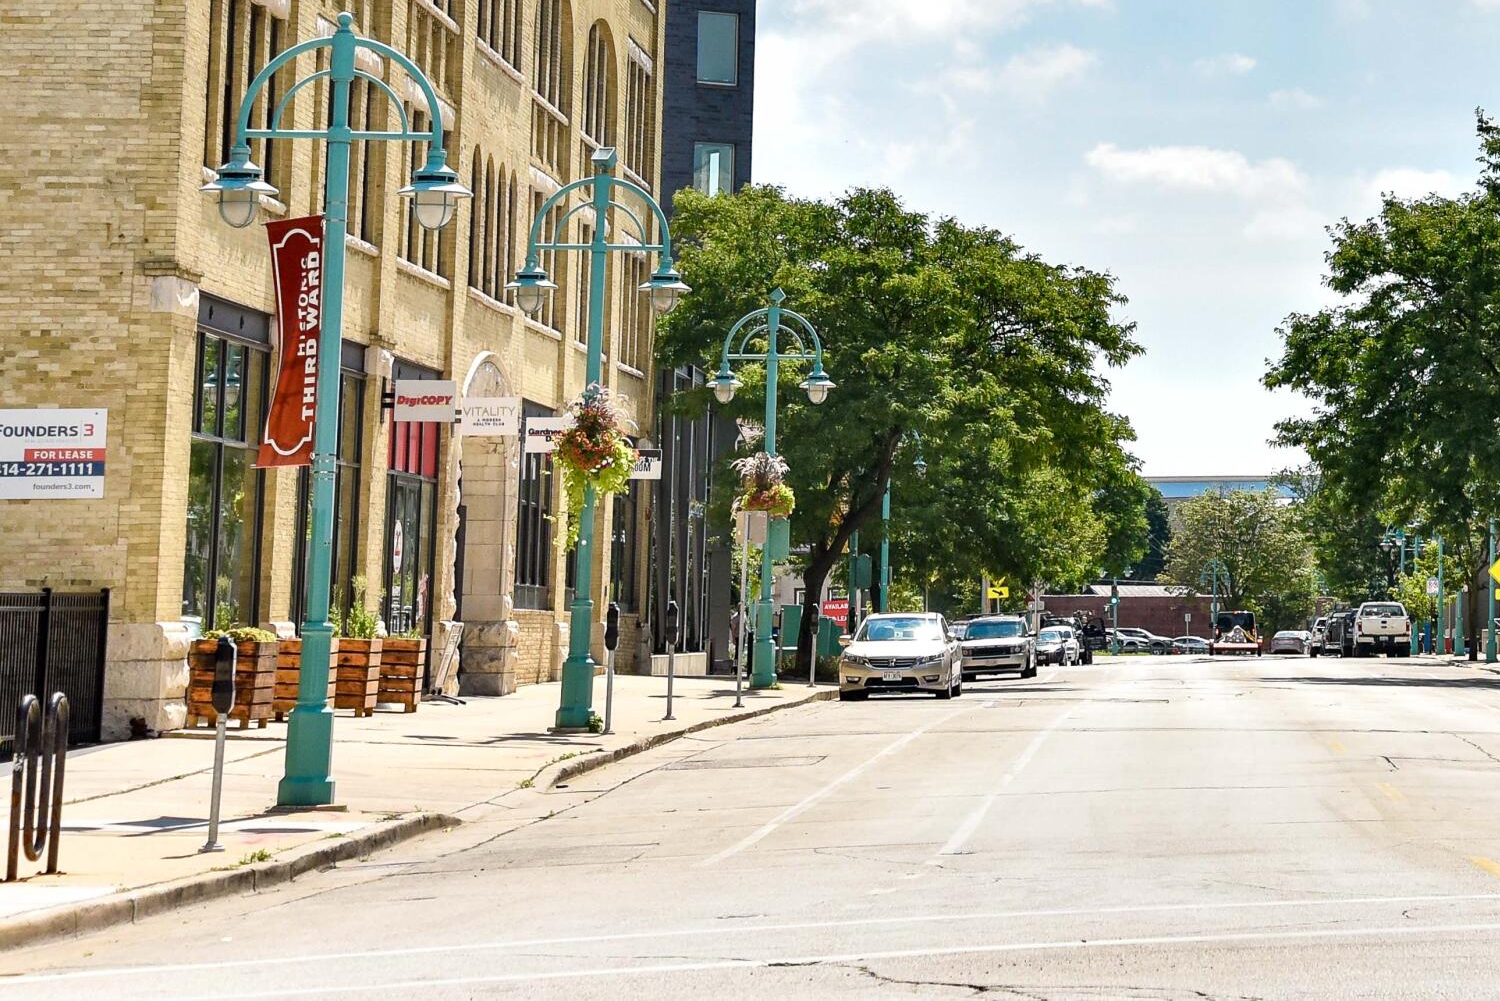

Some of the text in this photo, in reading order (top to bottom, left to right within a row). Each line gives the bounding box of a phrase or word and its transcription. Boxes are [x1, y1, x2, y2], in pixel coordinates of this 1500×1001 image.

[301, 251, 319, 422] THIRD WARD
[397, 395, 453, 407] DigiCOPY
[463, 406, 515, 417] VITALITY
[83, 423, 95, 437] 3
[33, 451, 93, 459] FOR LEASE
